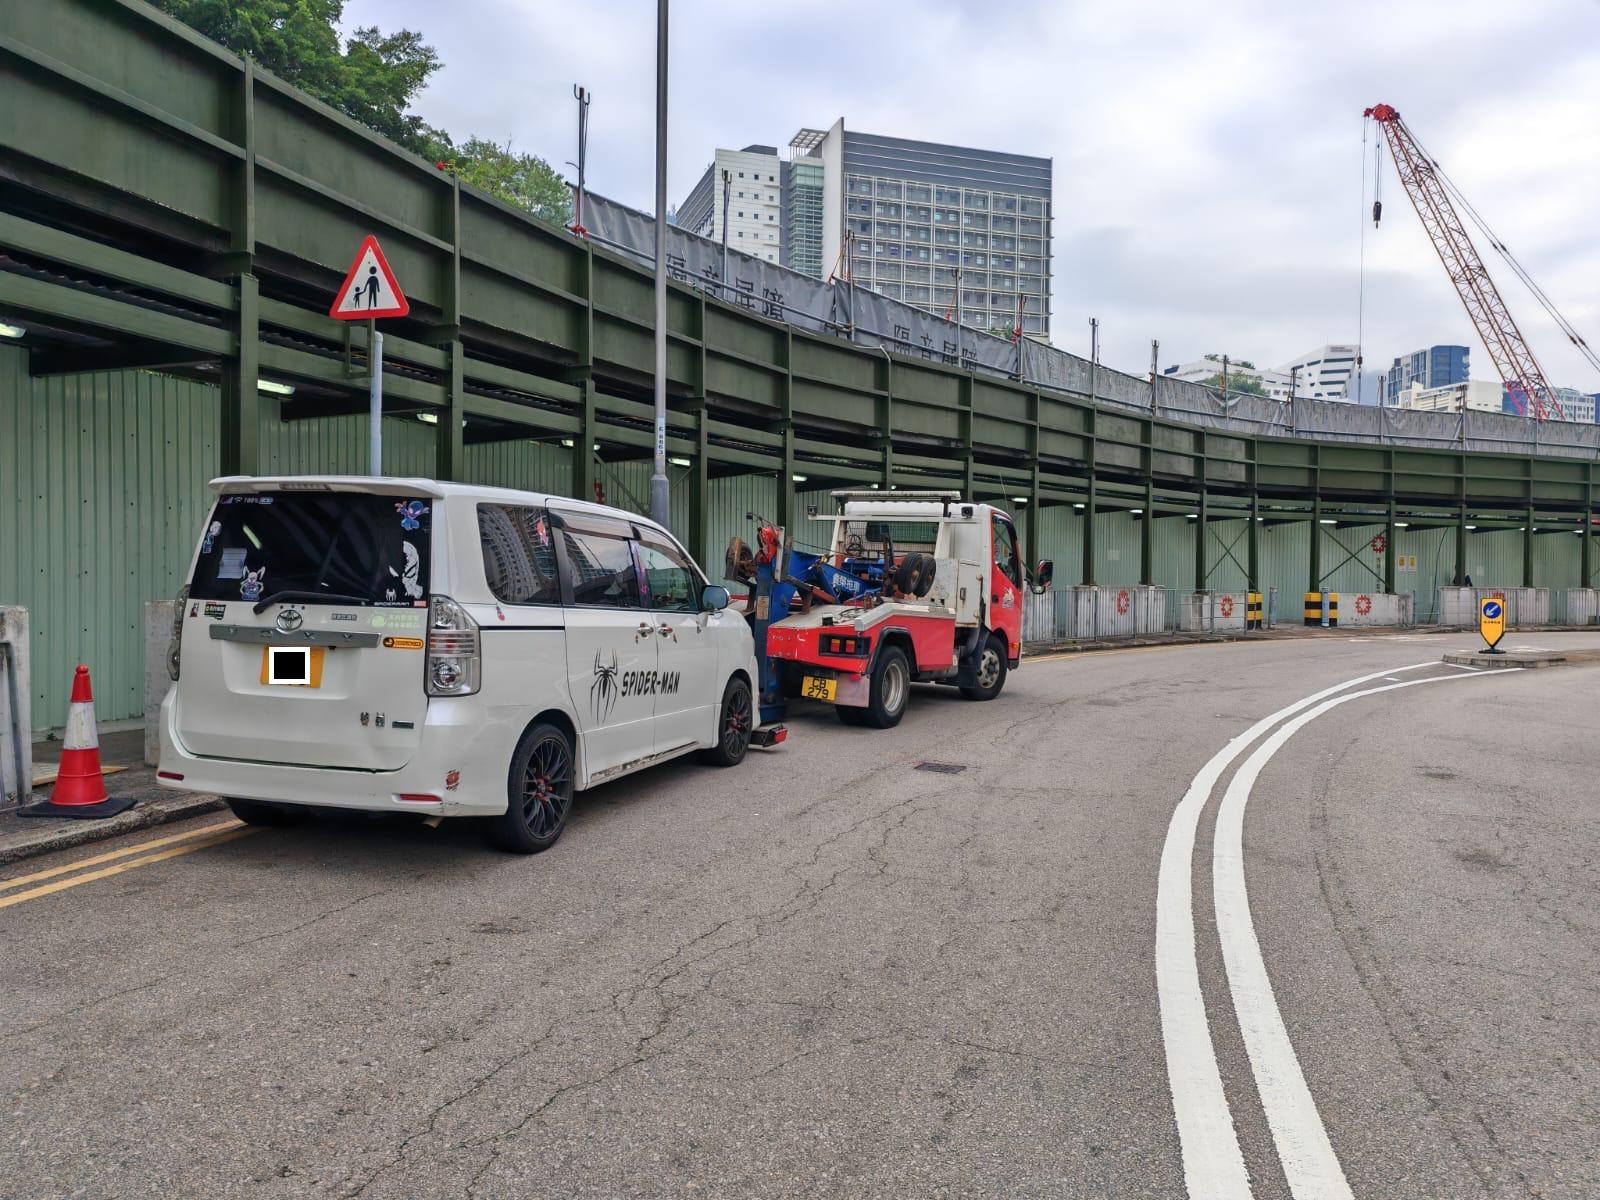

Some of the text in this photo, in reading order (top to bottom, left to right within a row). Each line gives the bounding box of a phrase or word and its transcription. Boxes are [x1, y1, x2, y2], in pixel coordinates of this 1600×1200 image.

[621, 670, 681, 697] SPIDER-MAN
[812, 677, 827, 689] CB
[807, 687, 829, 699] 279
